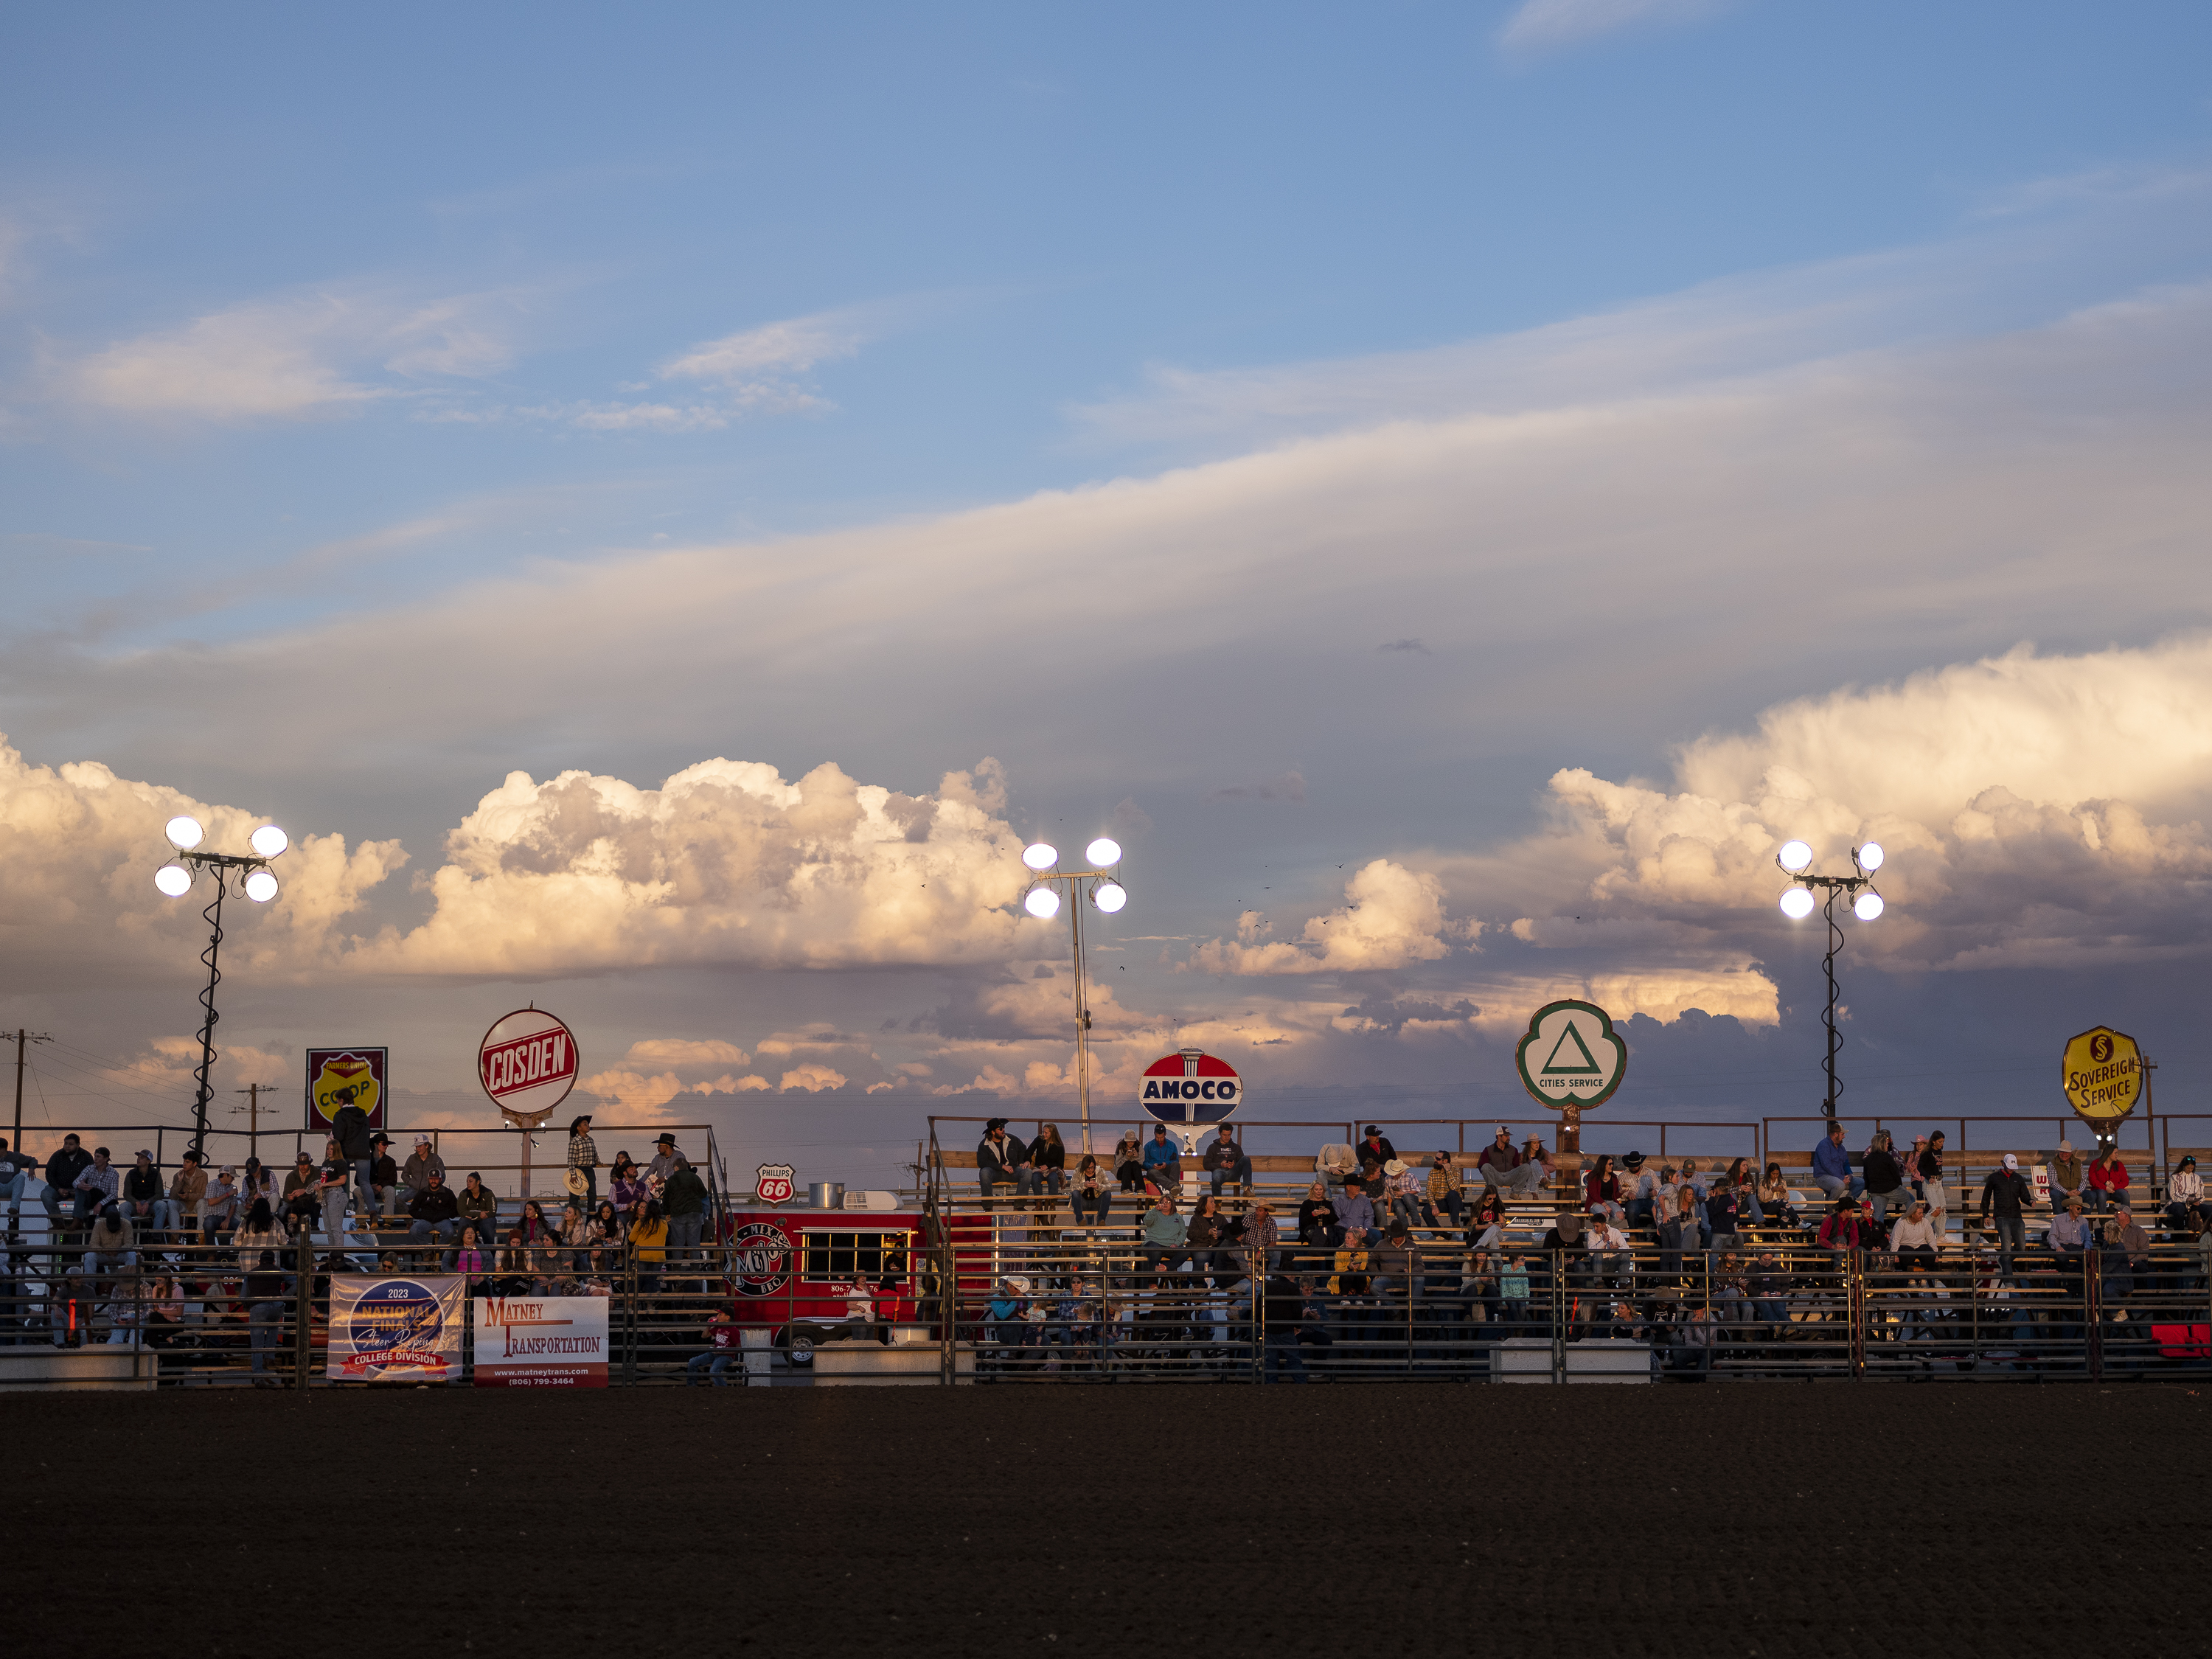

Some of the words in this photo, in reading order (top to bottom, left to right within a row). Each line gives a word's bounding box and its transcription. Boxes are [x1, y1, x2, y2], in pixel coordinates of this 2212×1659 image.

[326, 1062, 349, 1070] FARMERS
[489, 1033, 566, 1091] COSDEN
[2070, 1057, 2135, 1091] SOVEREIGN
[1143, 1080, 1237, 1100] AMOCO
[1540, 1079, 1565, 1088] CITIES
[1568, 1079, 1604, 1088] SERVICE
[2081, 1079, 2131, 1108] SERVICE
[762, 1169, 790, 1177] PHILLIPS
[762, 1180, 788, 1197] 66
[760, 1277, 782, 1294] BBQ
[388, 1289, 408, 1298] 2023
[362, 1306, 433, 1318] NATIONAL
[484, 1296, 543, 1327] MATNEY
[372, 1319, 422, 1332] FINALS
[355, 1328, 391, 1349] Steer
[394, 1329, 434, 1355] Roping
[503, 1324, 601, 1357] TRANSPORTATION
[354, 1352, 393, 1365] COLLEGE
[395, 1352, 437, 1366] DIVISION
[494, 1368, 588, 1377] www.matneytrans.com
[509, 1378, 532, 1386] (806)
[534, 1377, 574, 1385] 799-3464
